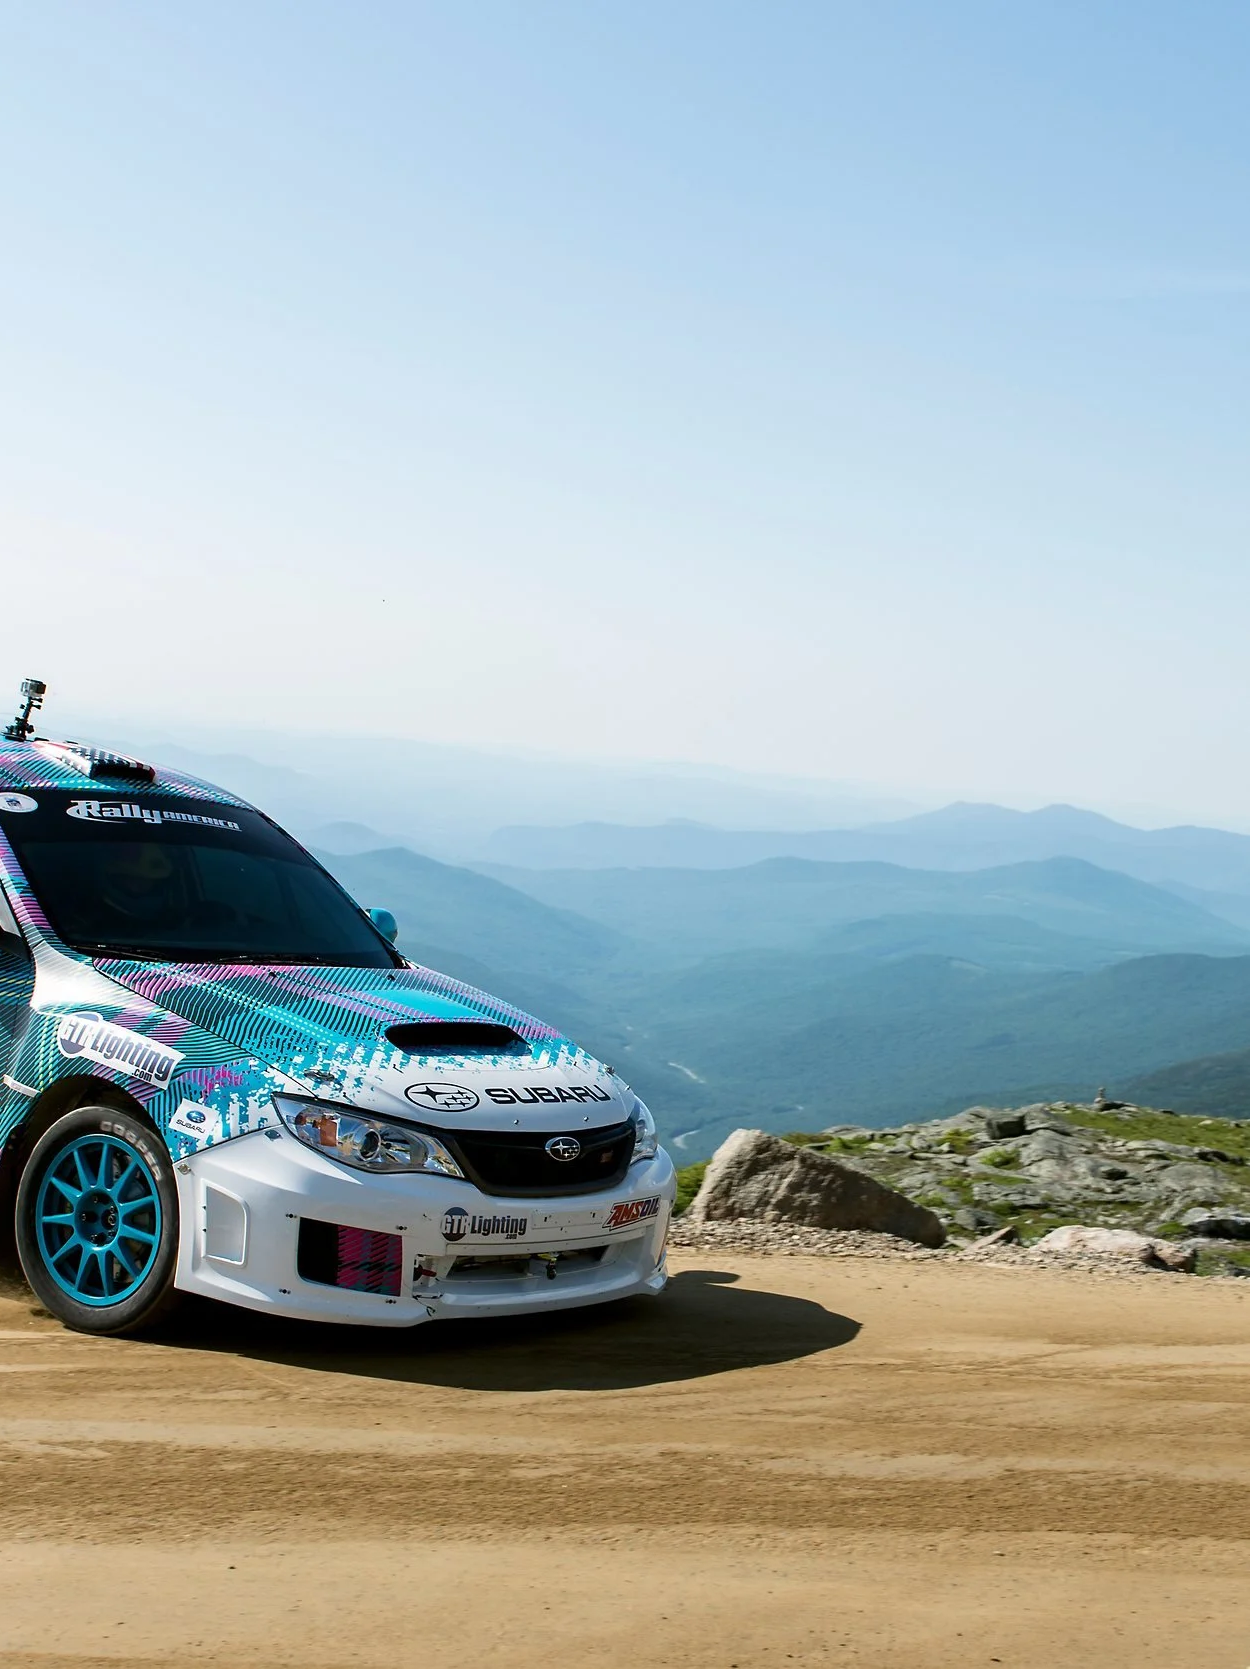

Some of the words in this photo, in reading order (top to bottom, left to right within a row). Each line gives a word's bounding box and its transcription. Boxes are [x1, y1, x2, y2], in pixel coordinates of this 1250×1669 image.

[69, 800, 162, 824] Rally
[90, 1027, 175, 1081] Lighting
[484, 1085, 611, 1105] SUBARU
[176, 1119, 205, 1133] SUBARU
[606, 1197, 659, 1227] AMSOIL
[470, 1216, 527, 1236] Lighting
